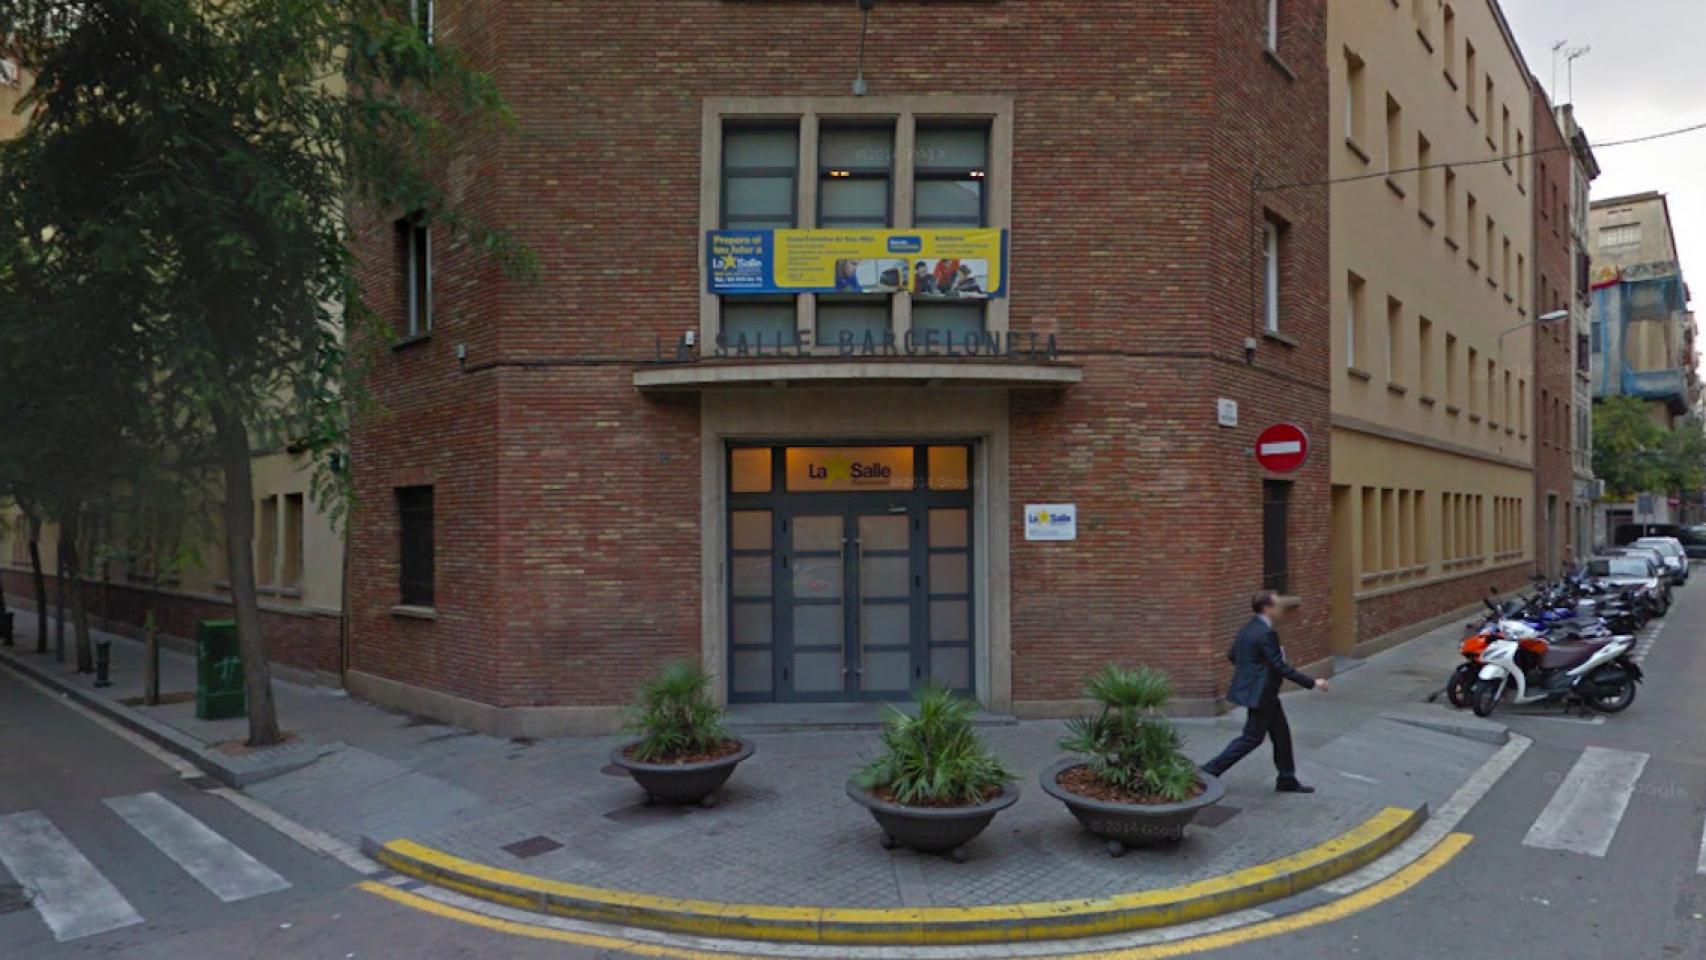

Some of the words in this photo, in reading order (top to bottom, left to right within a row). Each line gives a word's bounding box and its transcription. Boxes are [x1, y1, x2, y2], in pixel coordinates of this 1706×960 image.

[712, 258, 724, 269] La
[715, 330, 813, 358] SALLE
[838, 328, 1060, 361] BARCELONETA
[808, 463, 828, 479] La
[850, 461, 892, 479] Salle
[1028, 513, 1039, 524] La
[1049, 511, 1072, 523] Salle
